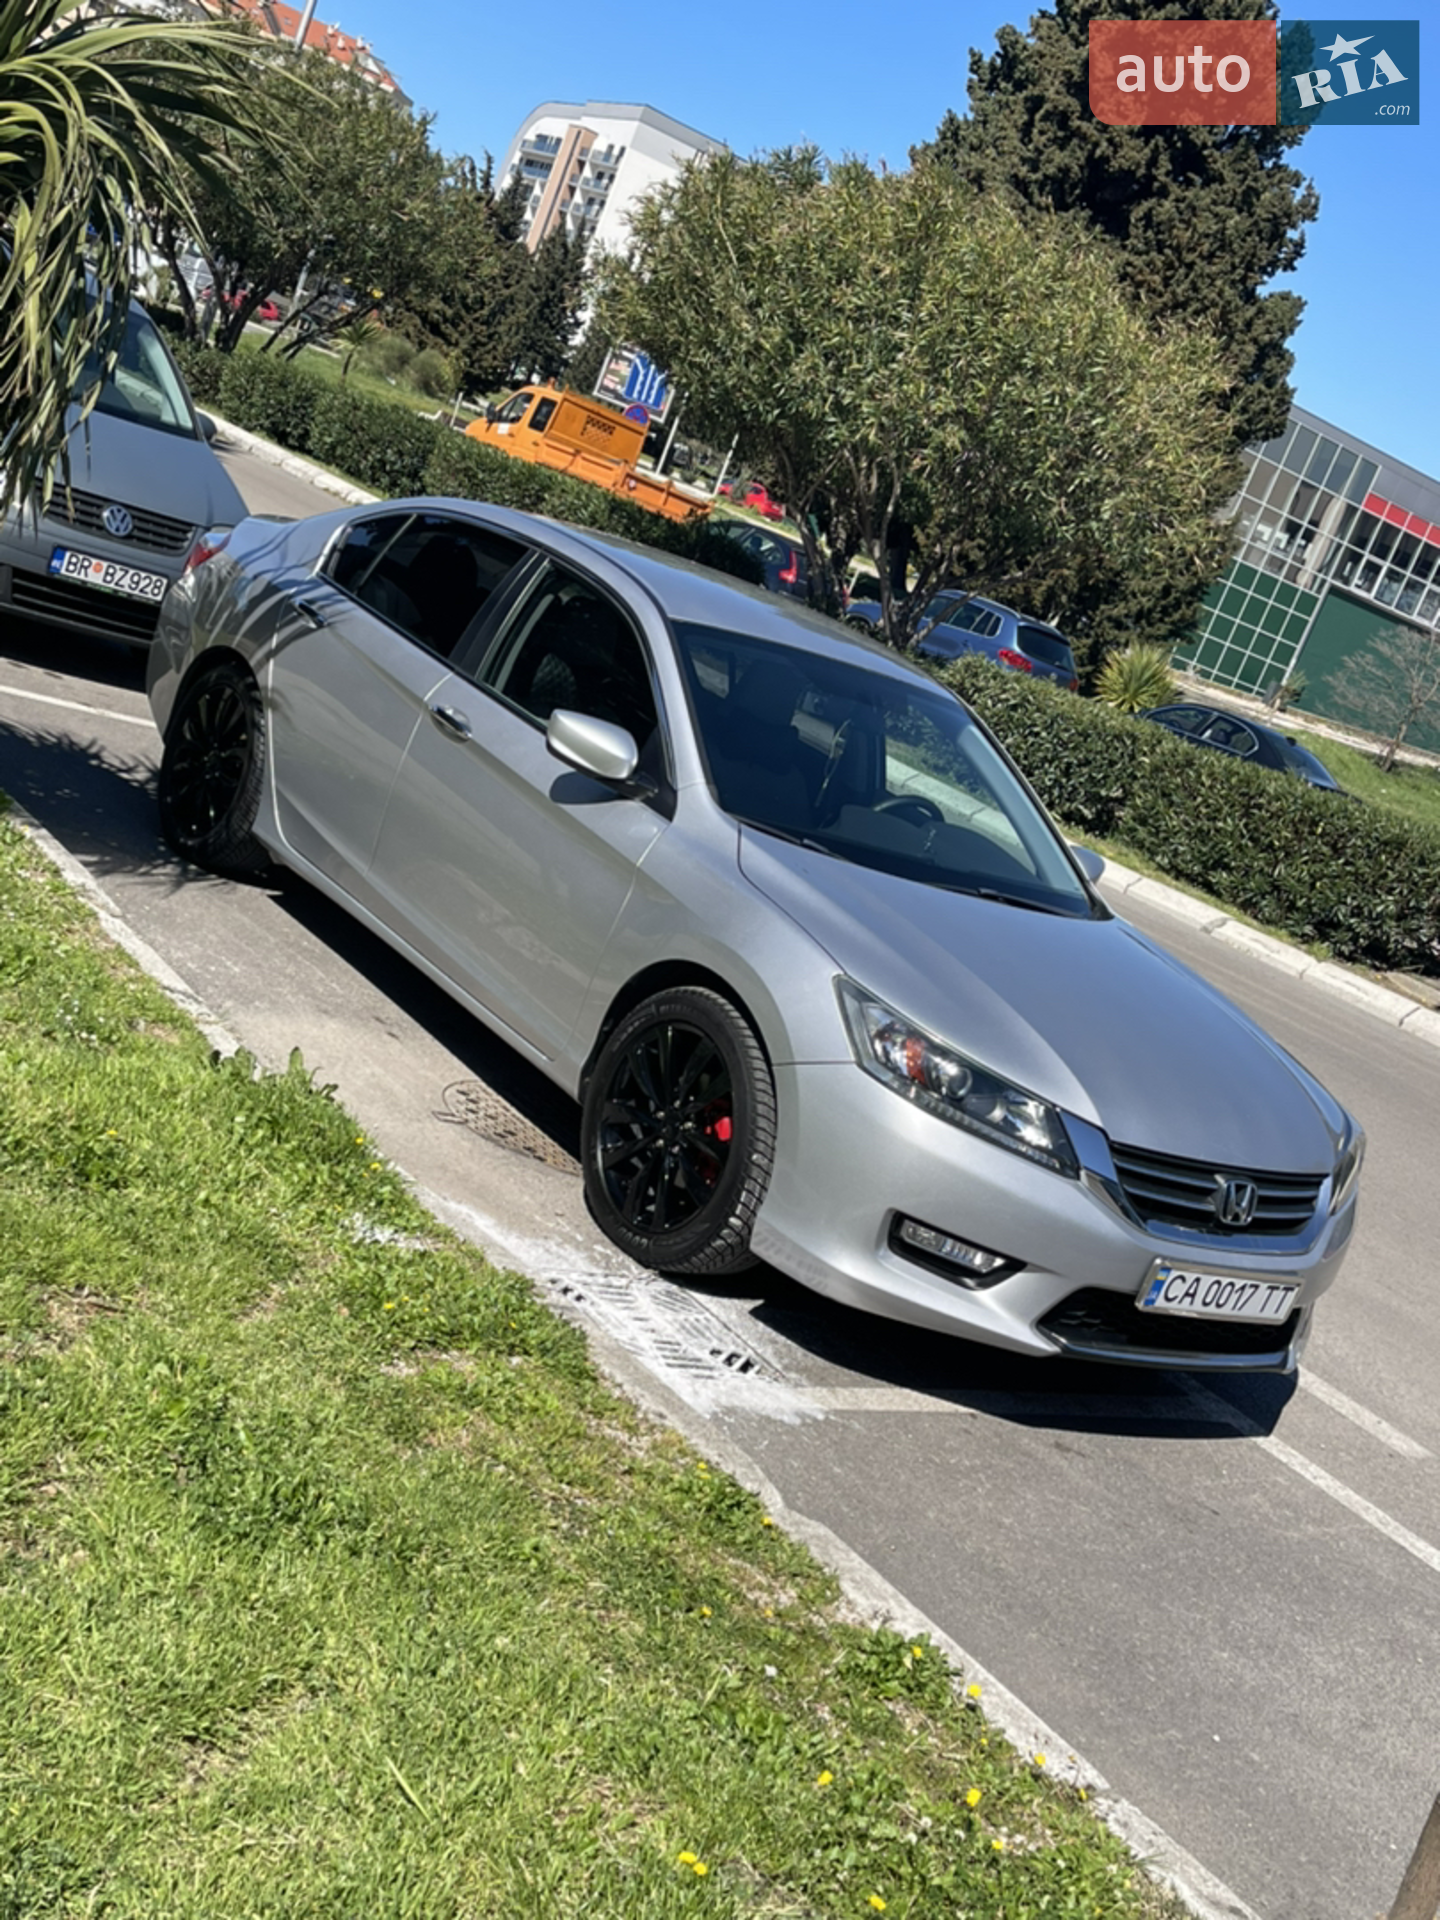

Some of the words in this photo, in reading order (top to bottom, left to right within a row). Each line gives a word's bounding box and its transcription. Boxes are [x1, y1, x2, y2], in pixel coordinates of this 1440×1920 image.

[66, 554, 92, 577] BR
[102, 566, 165, 597] BZ928
[1163, 1274, 1201, 1306] CA
[1202, 1279, 1260, 1312] 0017
[1259, 1285, 1295, 1314] TT
